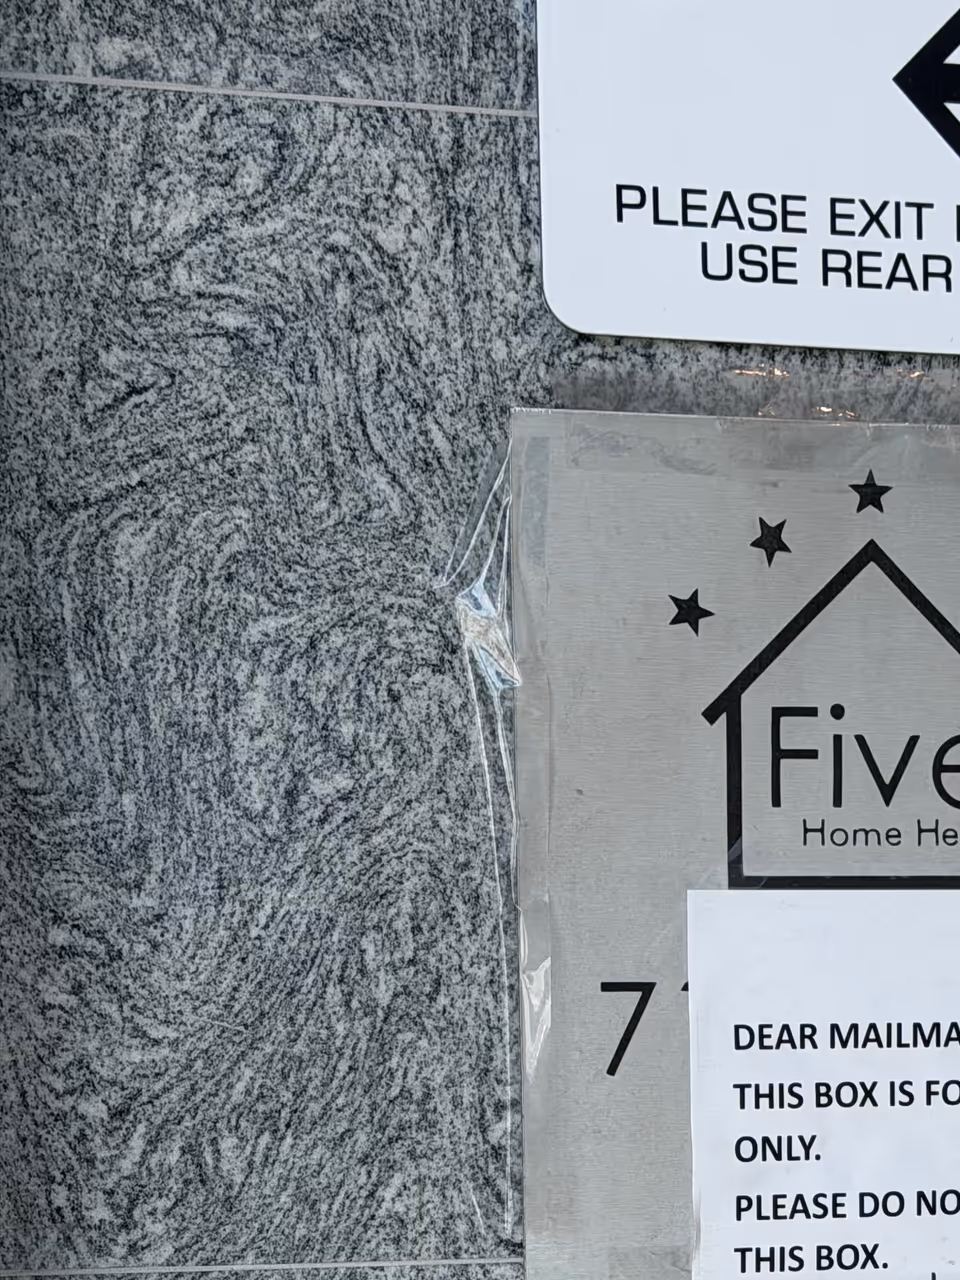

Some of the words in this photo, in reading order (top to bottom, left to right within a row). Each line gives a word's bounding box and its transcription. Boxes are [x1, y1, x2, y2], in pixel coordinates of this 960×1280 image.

[616, 184, 807, 233] PLEASE
[830, 198, 934, 240] EXIT
[702, 242, 797, 284] USE
[822, 249, 951, 292] REAR
[803, 819, 901, 846] Home
[734, 1024, 818, 1050] DEAR
[733, 1083, 803, 1109] THIS
[815, 1081, 878, 1108] BOX
[890, 1081, 914, 1106] IS
[735, 1135, 820, 1162] ONLY.
[736, 1193, 846, 1221] PLEASE
[859, 1191, 904, 1217] DO
[734, 1246, 804, 1273] THIS
[817, 1244, 888, 1270] BOX.
